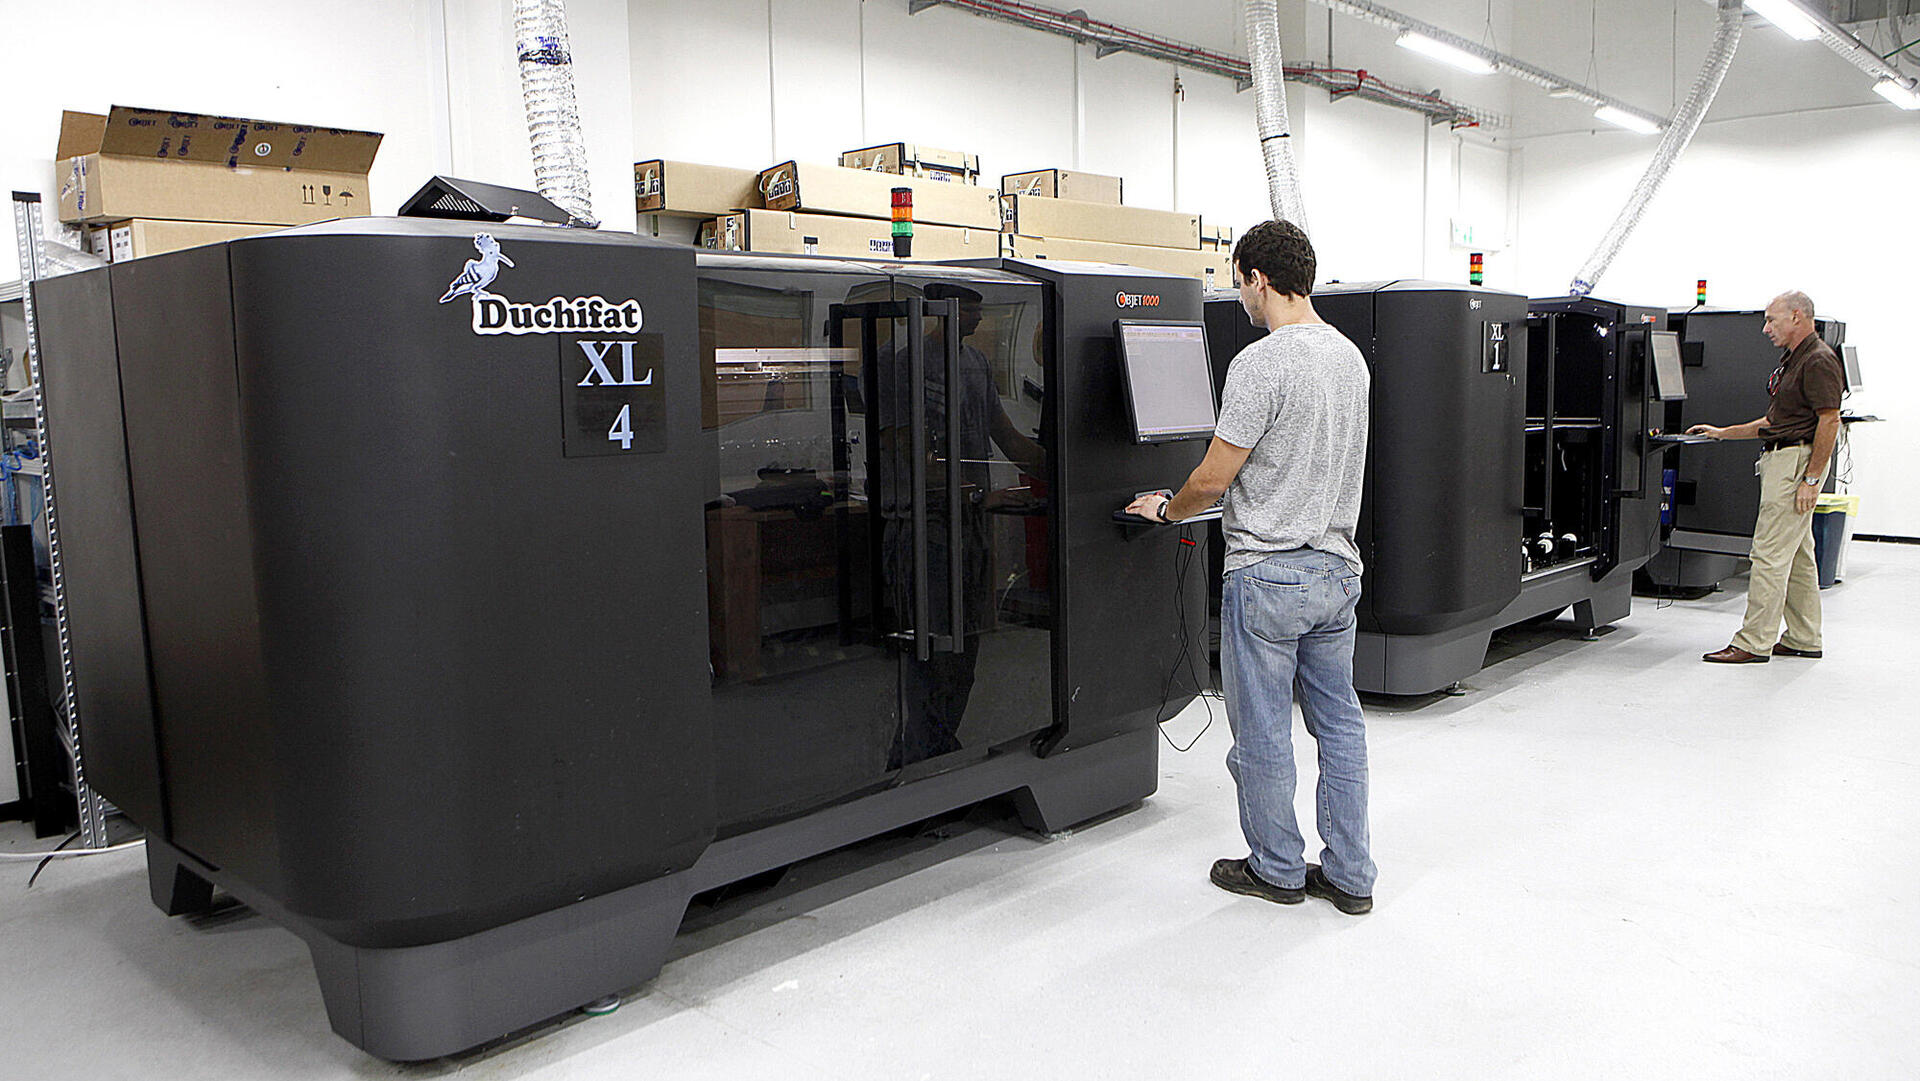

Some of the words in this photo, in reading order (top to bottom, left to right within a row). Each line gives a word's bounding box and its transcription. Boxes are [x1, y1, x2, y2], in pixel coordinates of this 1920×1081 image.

[479, 299, 638, 329] Duchifat
[1491, 324, 1504, 341] XL
[577, 340, 653, 387] XL
[1493, 342, 1500, 370] 1
[608, 403, 635, 450] 4
